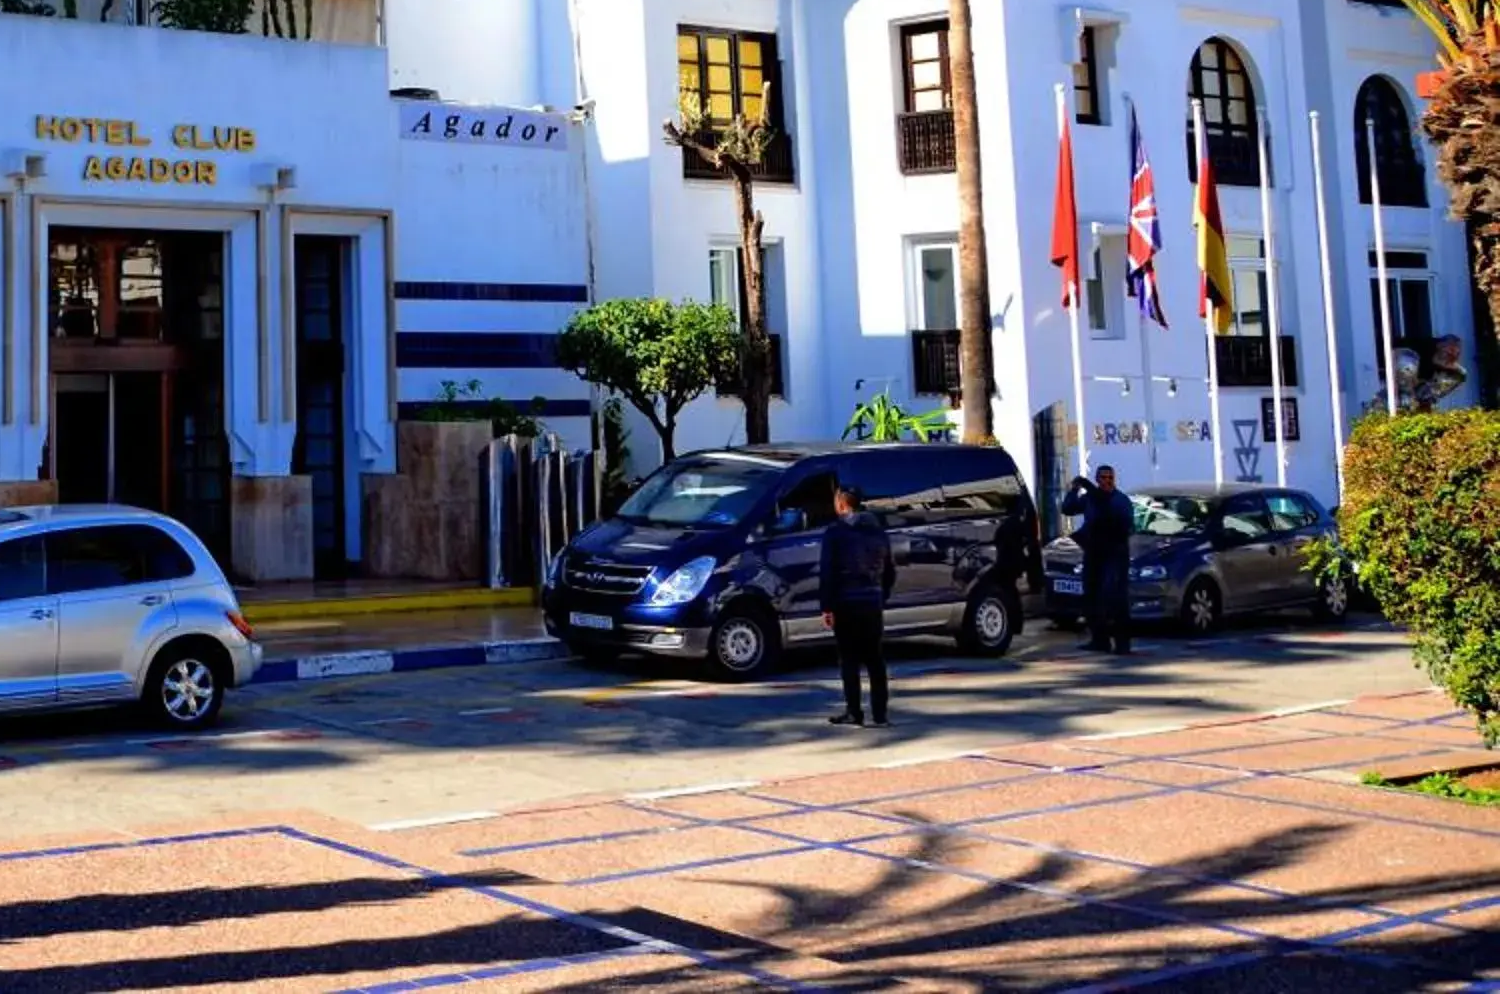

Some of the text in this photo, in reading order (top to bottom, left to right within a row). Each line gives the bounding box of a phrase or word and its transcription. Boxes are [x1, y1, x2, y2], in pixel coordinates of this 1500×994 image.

[35, 114, 256, 151] HOTEL CLUB
[411, 110, 559, 143] Agador
[83, 156, 217, 185] AGADOR
